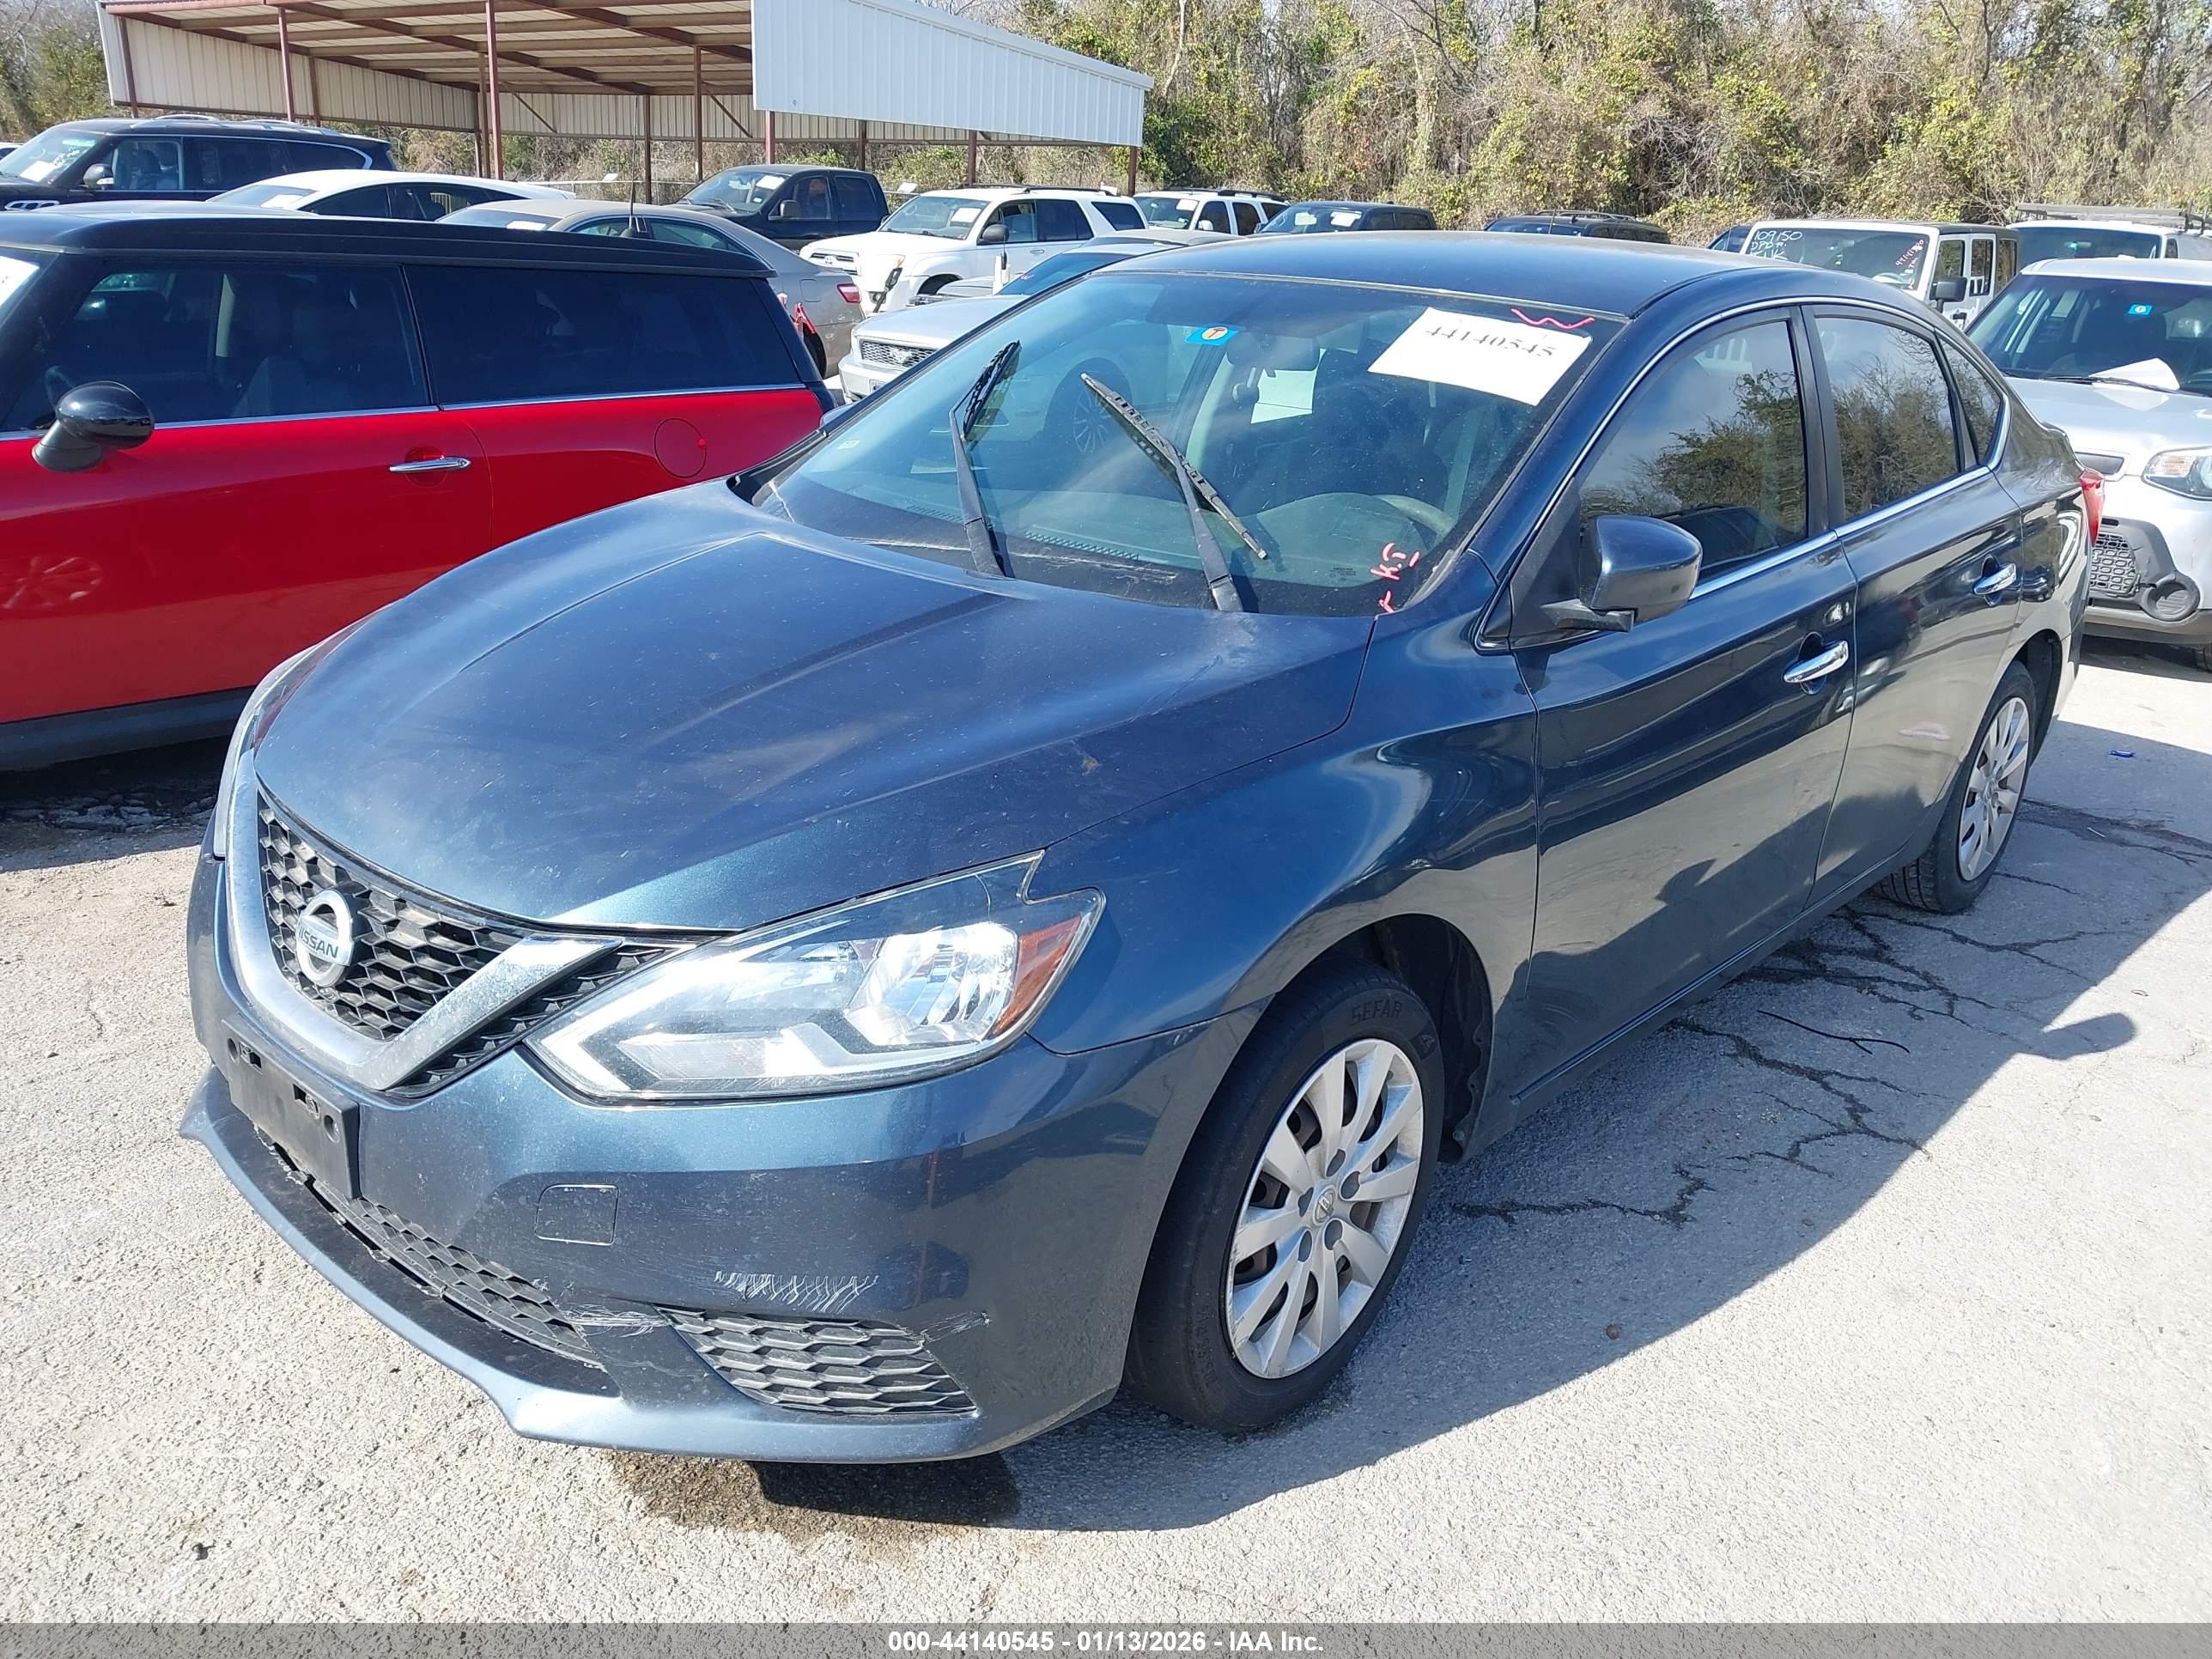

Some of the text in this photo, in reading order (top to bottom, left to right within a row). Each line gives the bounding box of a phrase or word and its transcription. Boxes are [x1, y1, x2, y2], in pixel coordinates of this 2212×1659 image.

[1207, 328, 1226, 339] T
[1425, 325, 1557, 357] 44140545
[298, 925, 338, 959] NISSAN
